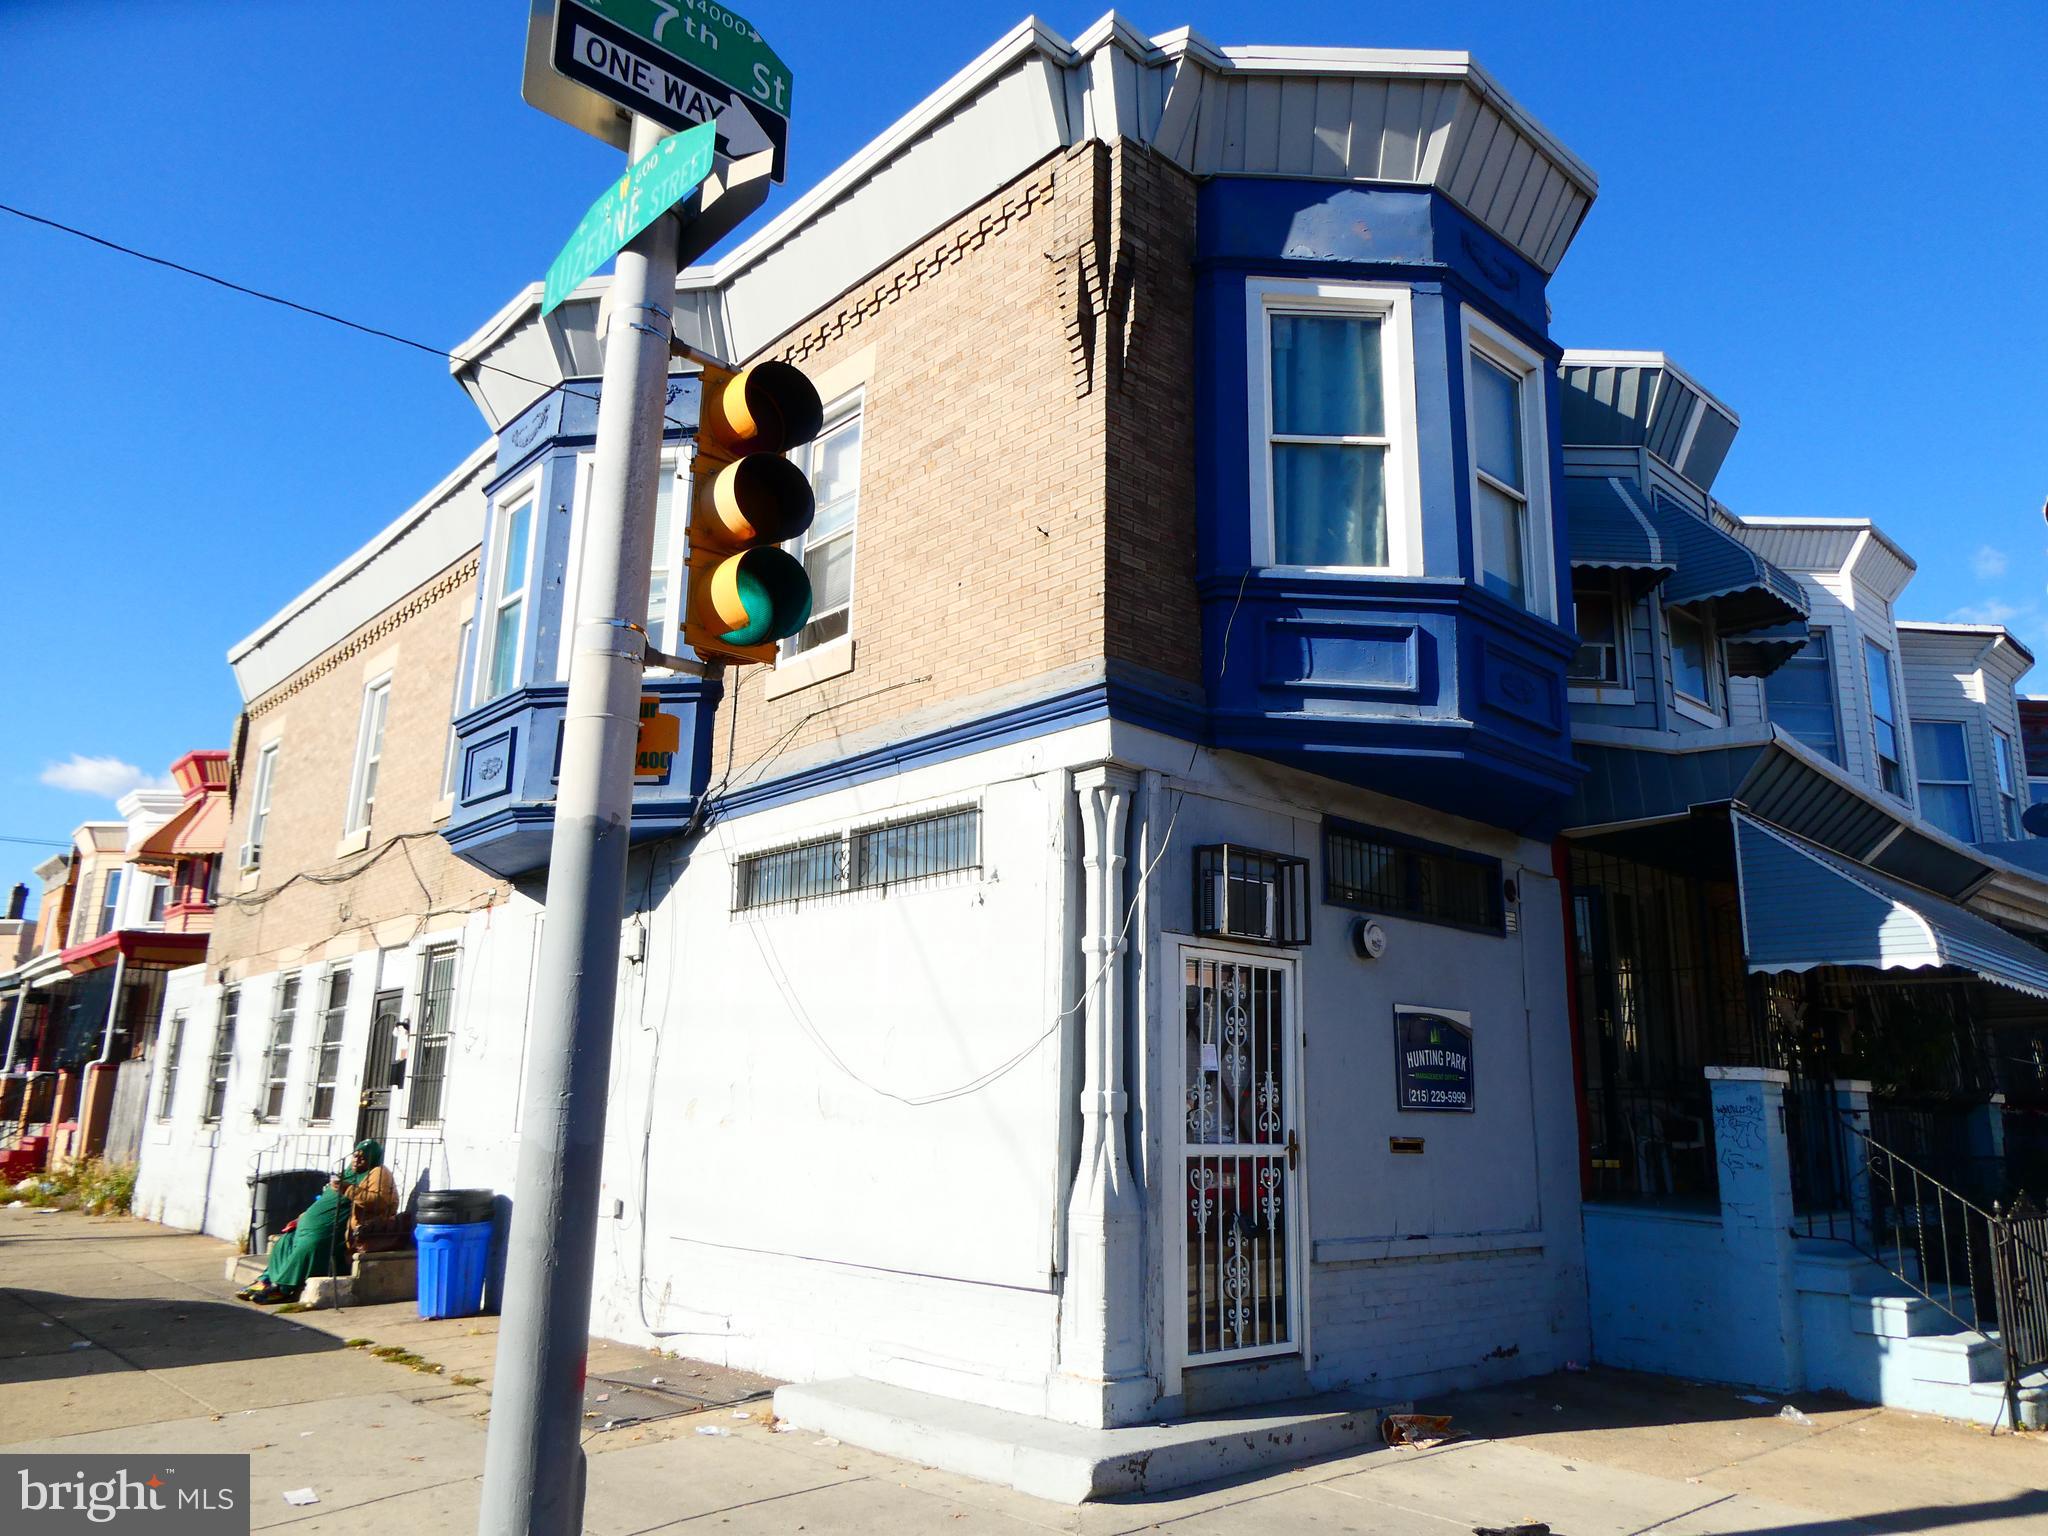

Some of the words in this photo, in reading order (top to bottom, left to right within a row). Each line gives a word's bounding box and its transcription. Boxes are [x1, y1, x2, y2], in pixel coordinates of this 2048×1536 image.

[586, 37, 652, 92] ONE
[664, 75, 726, 122] WAY
[752, 62, 785, 110] St
[650, 140, 711, 216] STREET
[1407, 1050, 1444, 1069] HUNTING
[1446, 1051, 1467, 1072] PARK
[1409, 1088, 1429, 1103] (215)
[1430, 1090, 1467, 1104] 229-5999
